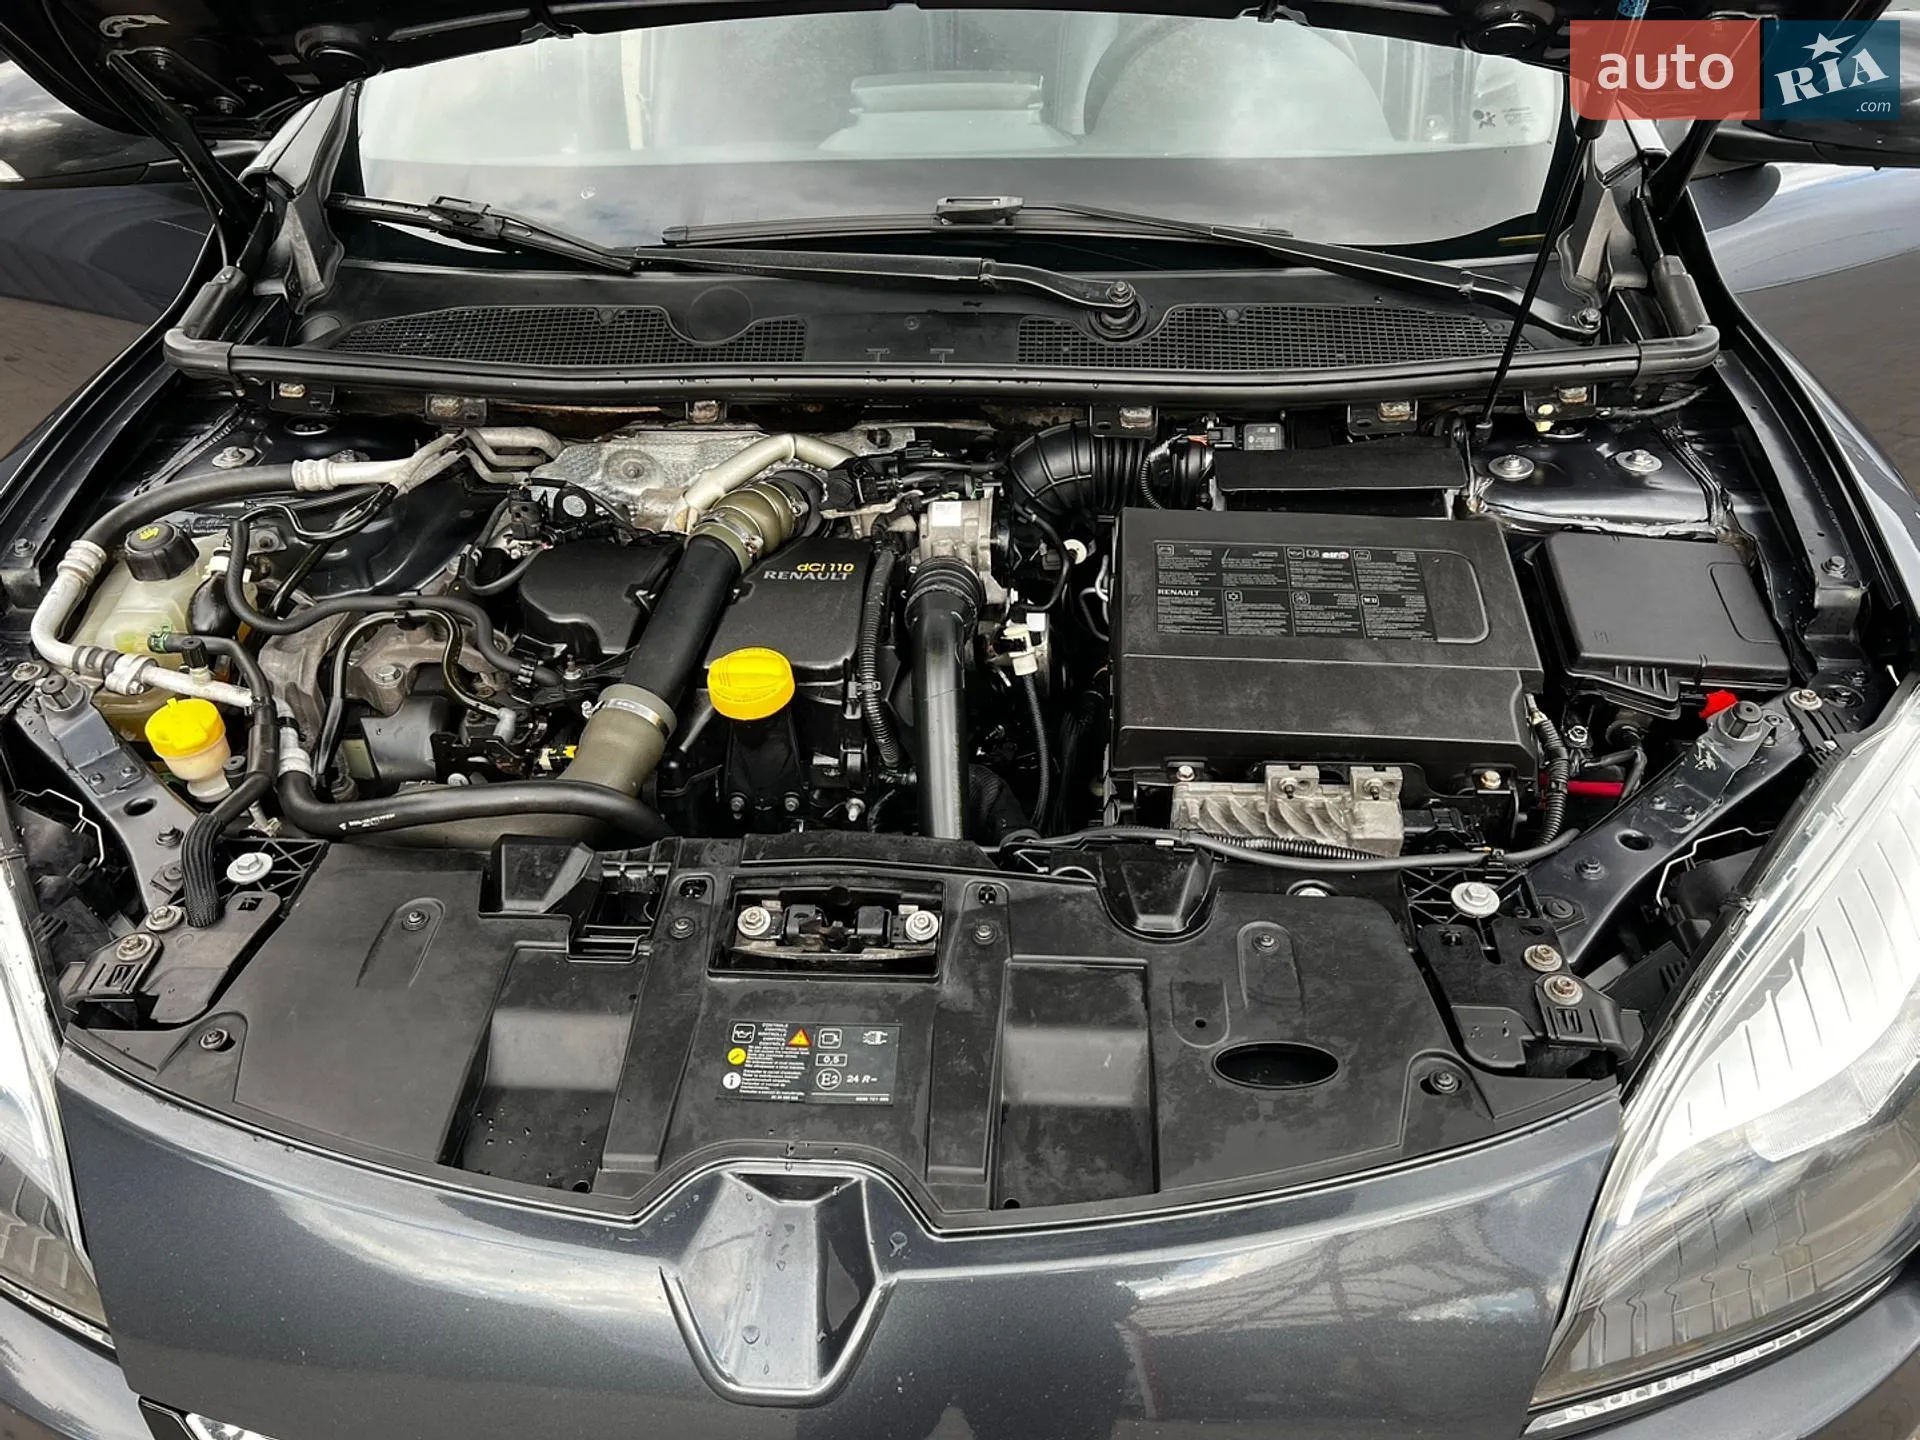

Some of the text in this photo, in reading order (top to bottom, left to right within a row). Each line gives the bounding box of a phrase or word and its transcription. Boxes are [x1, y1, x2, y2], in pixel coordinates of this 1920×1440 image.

[830, 563, 855, 572] 110
[763, 570, 852, 580] RENAULT
[1157, 588, 1201, 597] RENAULT
[820, 1073, 839, 1086] E2
[846, 1074, 859, 1083] 24
